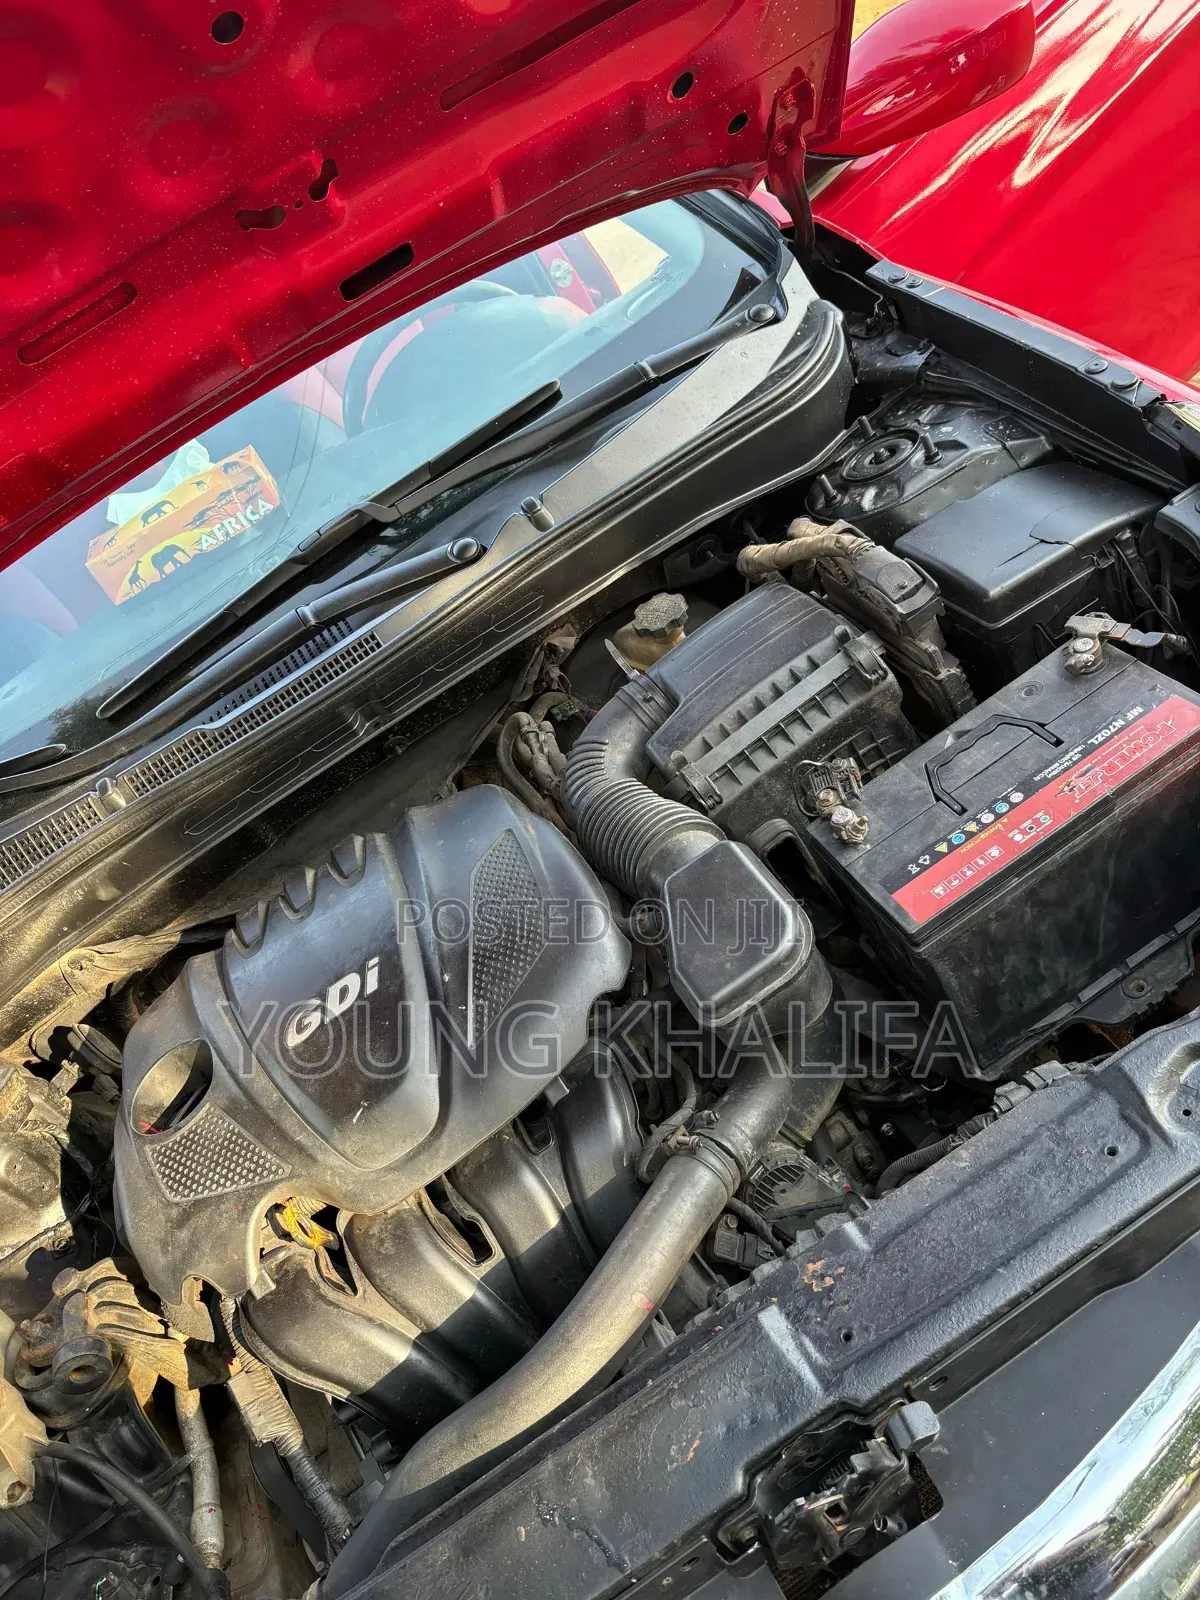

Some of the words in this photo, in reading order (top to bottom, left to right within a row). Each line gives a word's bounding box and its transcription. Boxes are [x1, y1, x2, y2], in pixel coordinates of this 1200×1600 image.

[201, 498, 275, 551] AFRICA
[1087, 718, 1126, 745] N70ZL
[1125, 705, 1145, 721] MF
[285, 956, 380, 1049] GDi
